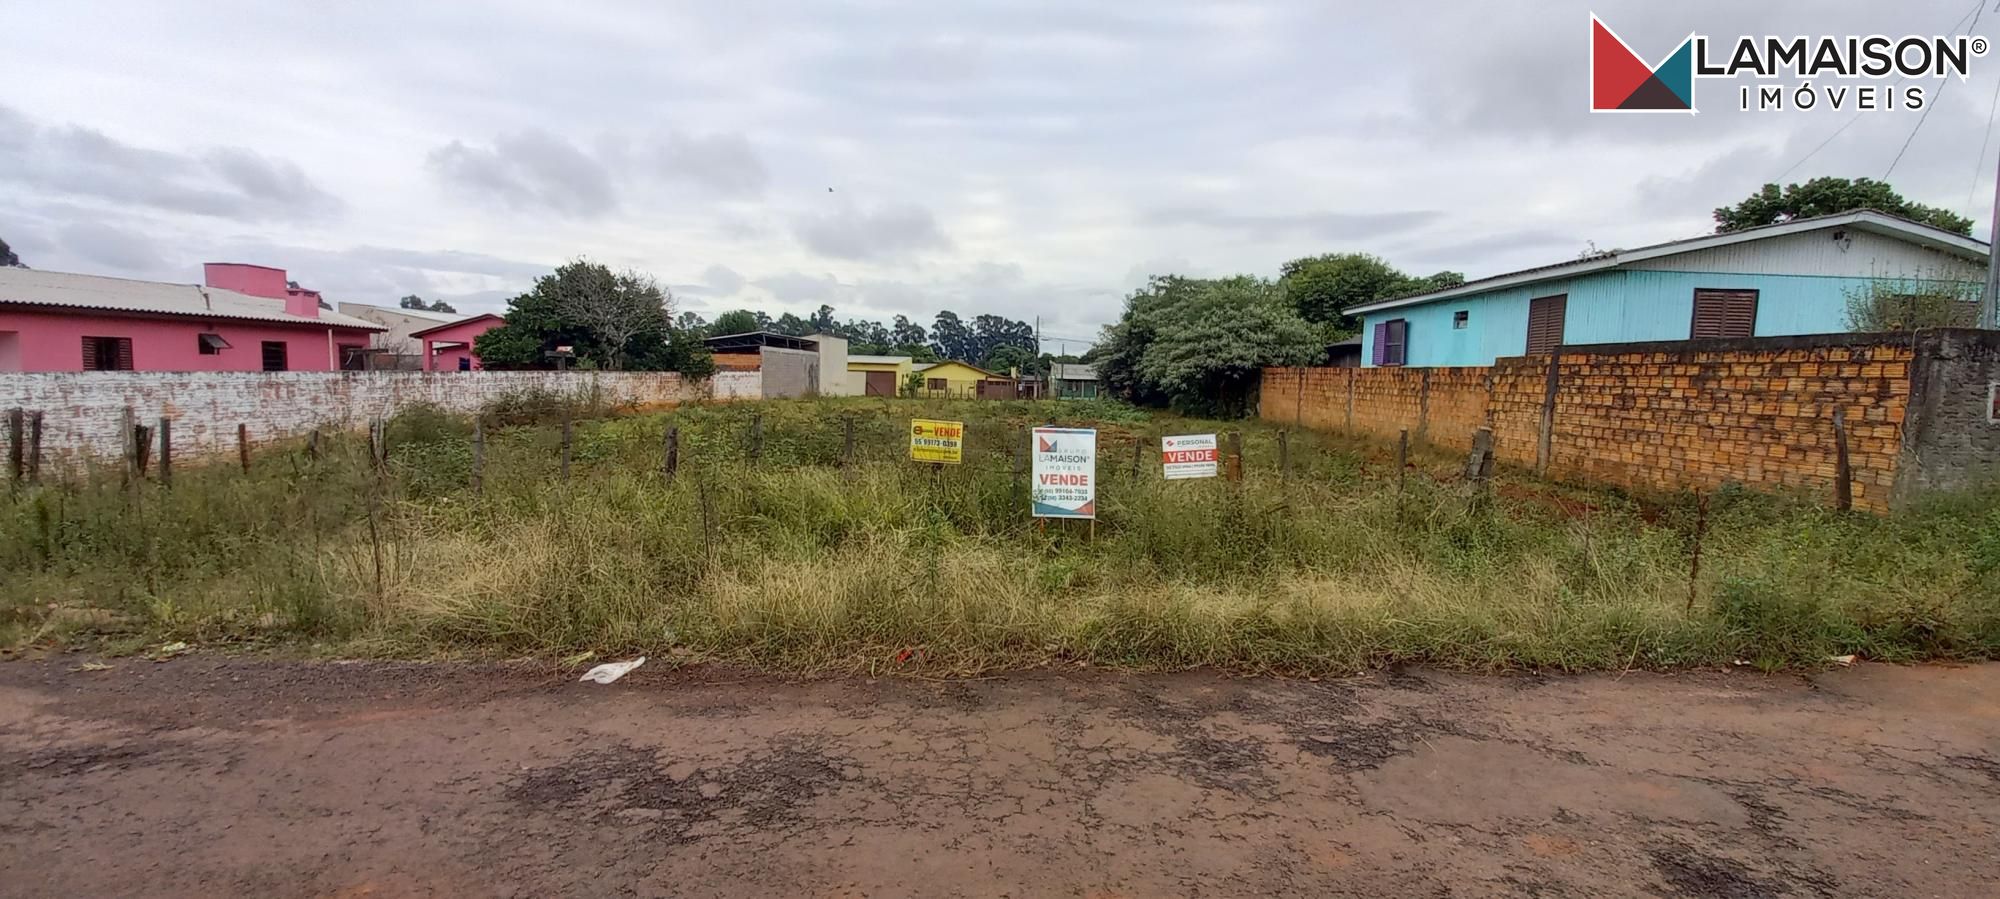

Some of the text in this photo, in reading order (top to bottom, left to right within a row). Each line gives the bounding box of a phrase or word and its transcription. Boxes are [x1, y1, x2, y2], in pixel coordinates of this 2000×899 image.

[934, 426, 961, 438] VENDE
[1167, 450, 1213, 462] VENDE
[1039, 473, 1088, 486] VENDE
